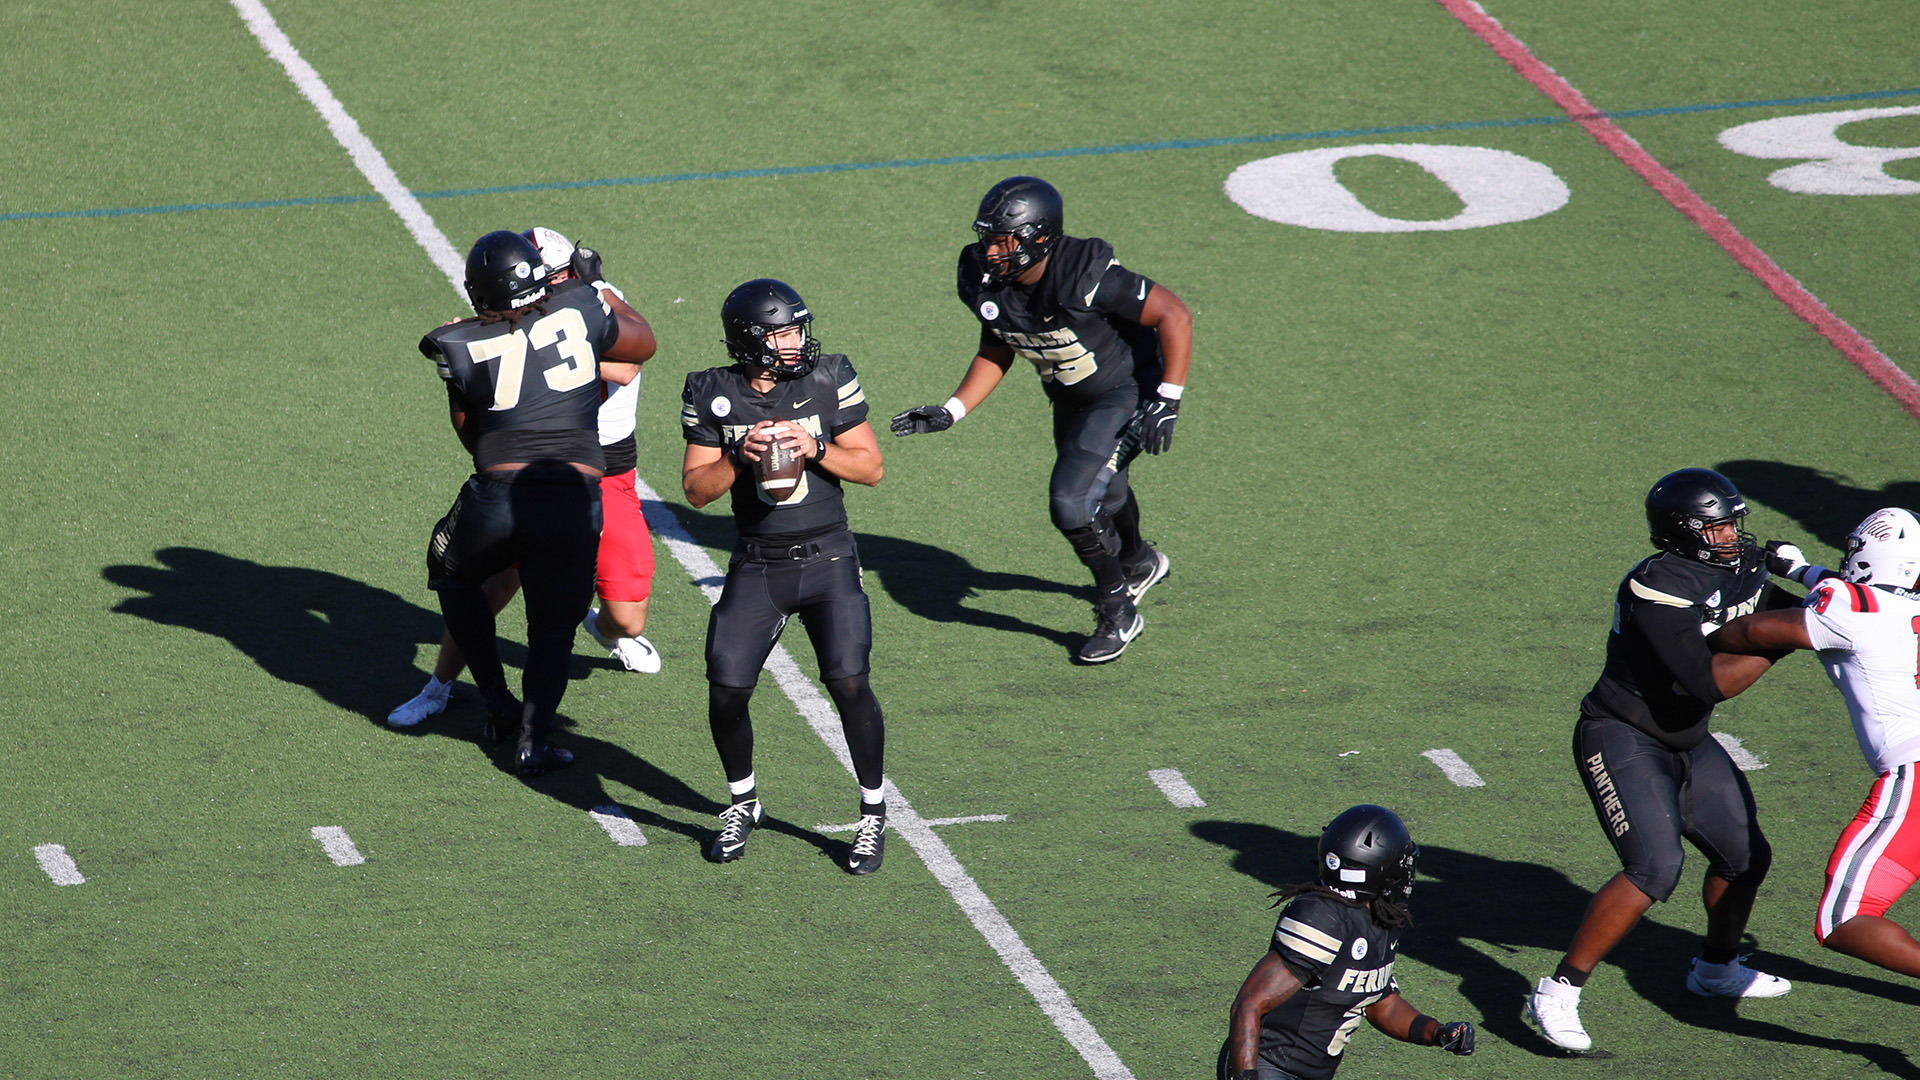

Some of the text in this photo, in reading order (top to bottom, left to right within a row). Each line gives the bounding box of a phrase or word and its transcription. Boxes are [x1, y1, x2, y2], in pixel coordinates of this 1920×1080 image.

[466, 307, 597, 412] 73
[721, 414, 824, 445] FEM
[1894, 586, 1920, 602] Ridd
[1586, 751, 1631, 838] PANTHERS
